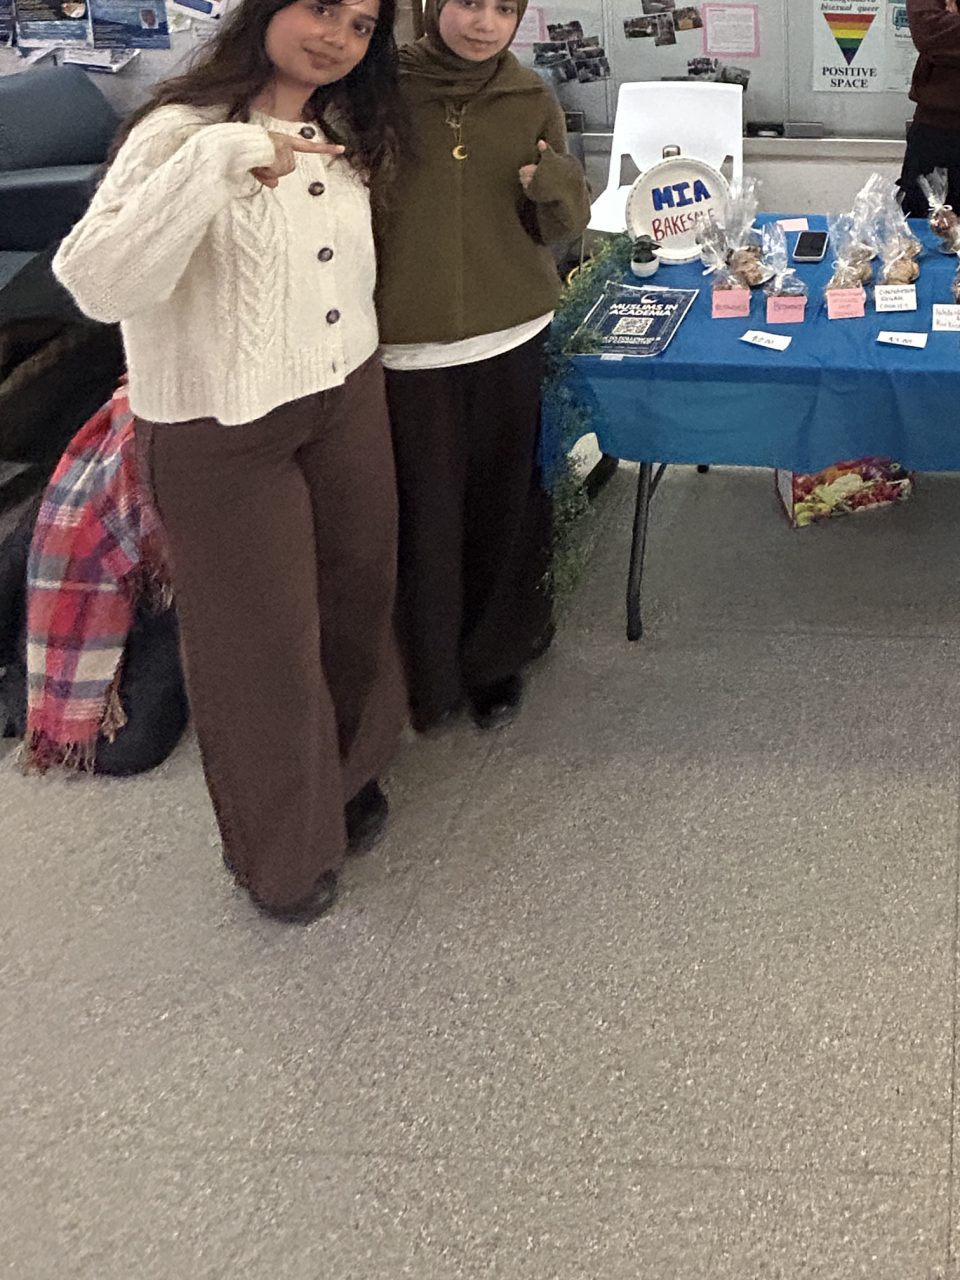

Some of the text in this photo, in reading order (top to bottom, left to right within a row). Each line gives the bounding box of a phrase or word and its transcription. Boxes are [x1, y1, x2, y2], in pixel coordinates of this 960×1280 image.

[820, 3, 880, 13] bisexual queer
[822, 66, 878, 77] POSITIVE
[830, 78, 869, 88] SPACE
[651, 179, 712, 211] MIA
[610, 303, 678, 311] MUSLIMS IN
